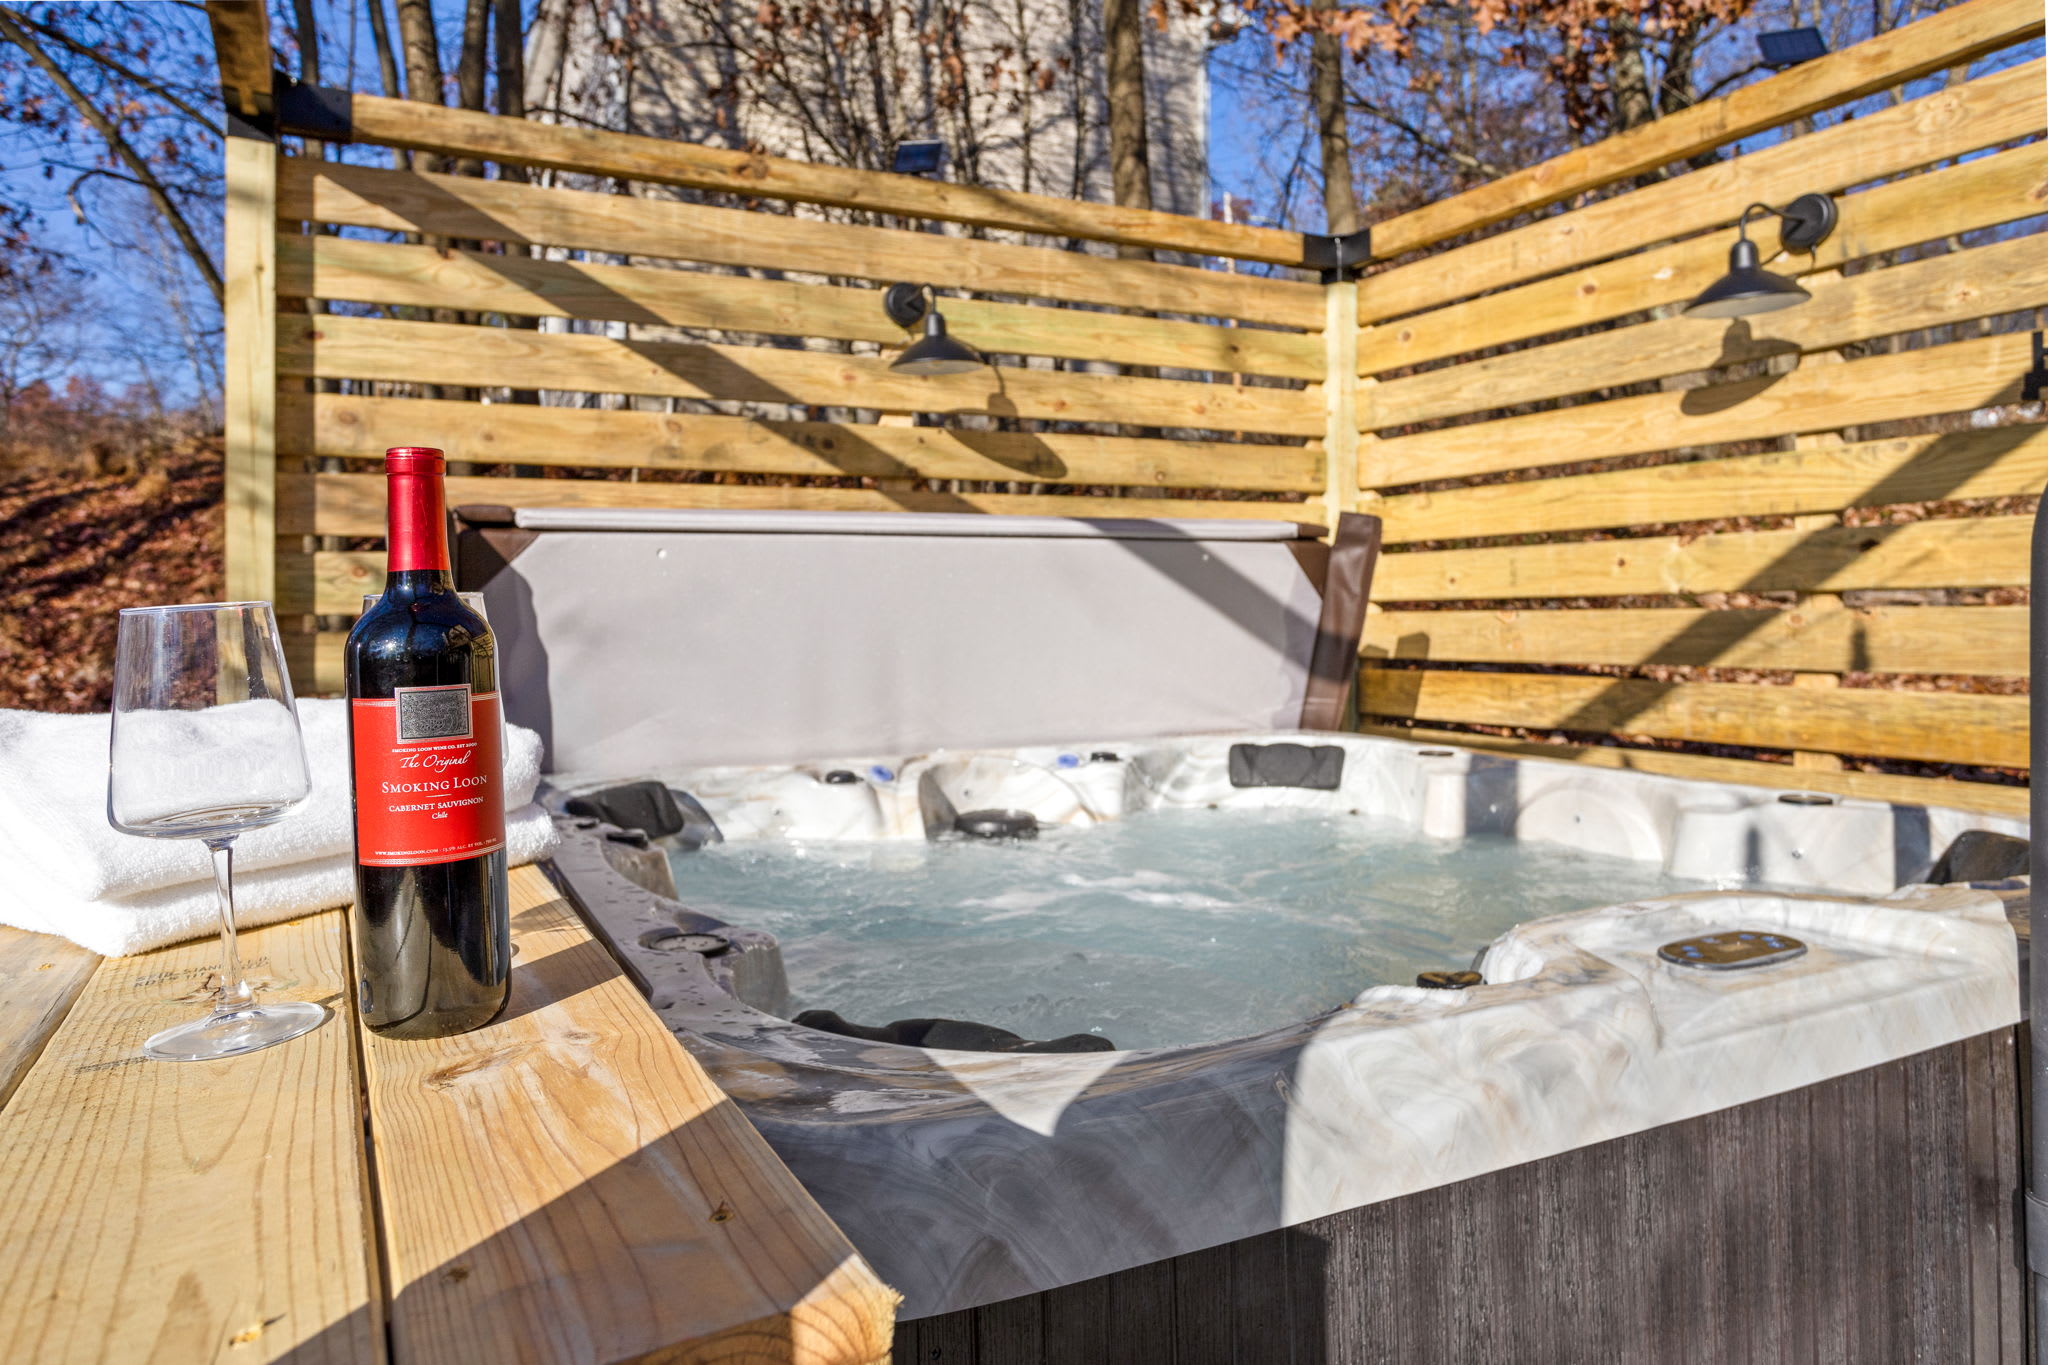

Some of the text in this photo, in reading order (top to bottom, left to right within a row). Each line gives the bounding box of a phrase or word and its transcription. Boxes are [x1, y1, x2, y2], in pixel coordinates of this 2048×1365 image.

[399, 749, 472, 773] The Original
[382, 775, 488, 794] SMOKING LOON
[388, 796, 484, 812] CABERNET SAUVIGNON
[431, 811, 448, 820] Chile
